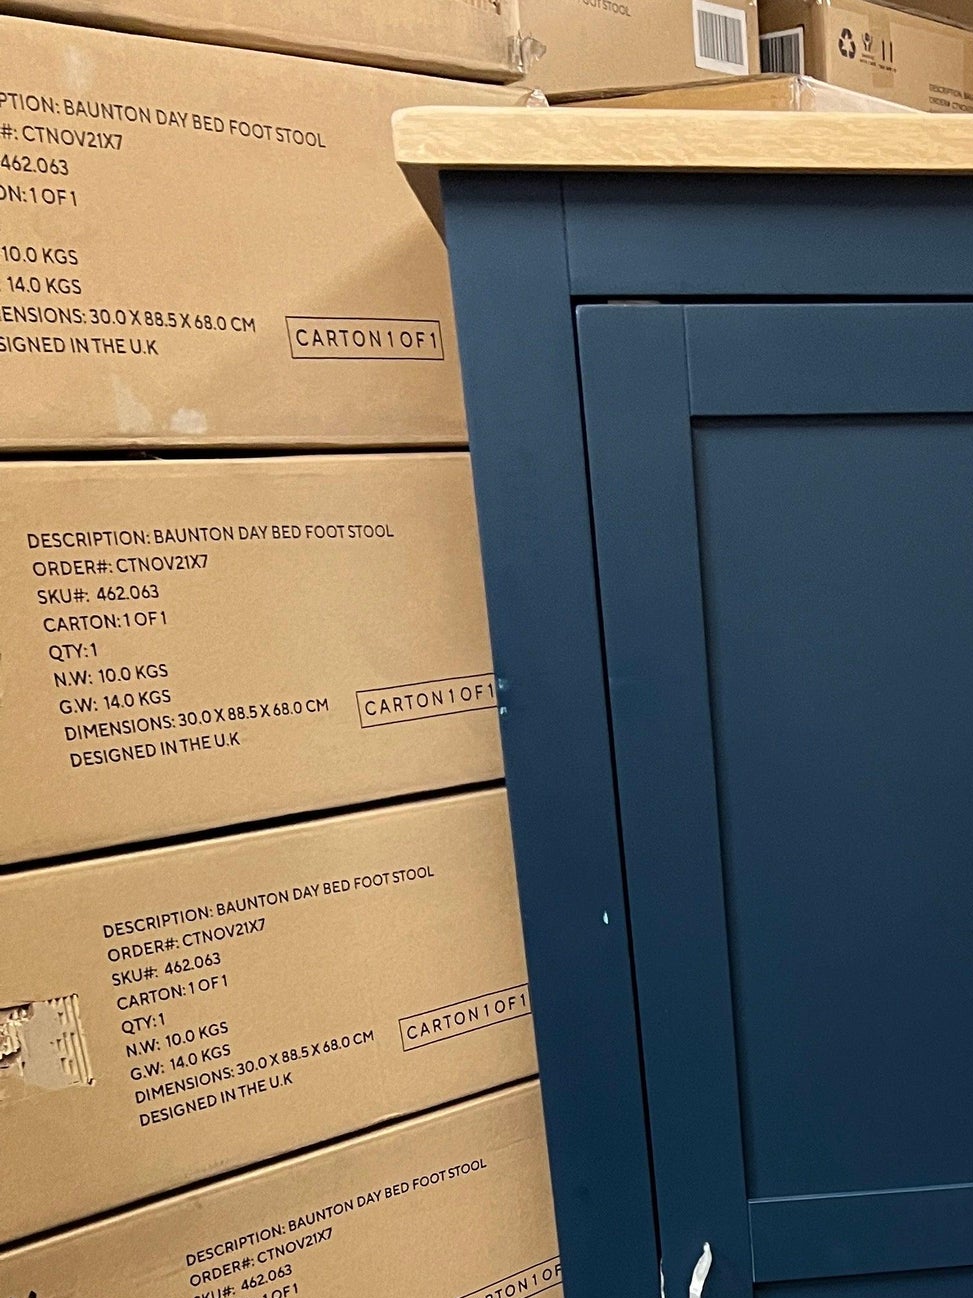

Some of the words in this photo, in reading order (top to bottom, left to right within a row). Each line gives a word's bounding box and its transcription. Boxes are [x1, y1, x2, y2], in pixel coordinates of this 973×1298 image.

[22, 125, 123, 151] CTNOV21X7
[63, 99, 151, 124] BAUNTON
[155, 109, 188, 128] DAY
[192, 114, 225, 133] BED
[229, 119, 273, 141] FOOT
[275, 126, 327, 149] STOOL
[0, 154, 69, 176] 462.063
[1, 245, 38, 263] 10.0
[42, 247, 79, 266] KGS
[6, 276, 41, 294] 14.0
[45, 277, 82, 295] KGS
[89, 308, 126, 325] 30.0
[144, 311, 177, 328] 88.5
[194, 314, 227, 331] 68.0
[231, 316, 256, 333] CM
[129, 338, 159, 355] U.K
[295, 328, 382, 348] CARTON
[400, 331, 425, 348] OF
[27, 530, 151, 549] DESCRIPTION:
[153, 526, 234, 544] BAUNTON
[238, 525, 268, 540] DAY
[271, 525, 302, 539] BED
[305, 525, 345, 539] FOOT
[347, 524, 394, 538] STOOL
[32, 559, 113, 577] ORDER#:
[116, 554, 208, 573] CTNOV21X7
[37, 588, 90, 605] SKU#:
[96, 584, 159, 602] 462.063
[53, 670, 93, 688] N.W:
[98, 666, 131, 683] 10.0
[135, 663, 168, 680] KGS
[59, 697, 98, 715] G.W:
[103, 693, 135, 710] 14.0
[138, 689, 171, 706] KGS
[364, 690, 444, 716] CARTON
[460, 684, 483, 701] OF
[64, 715, 176, 741] DIMENSIONS:
[177, 710, 212, 727] 30.0
[227, 705, 258, 721] 88.5
[273, 701, 303, 717] 68.0
[305, 698, 329, 713] CM
[70, 743, 157, 768] DESIGNED
[213, 731, 241, 748] U.K
[102, 906, 214, 939] DESCRIPTION:
[216, 890, 289, 916] BAUNTON
[292, 883, 320, 901] DAY
[323, 879, 351, 895] BED
[354, 872, 390, 890] FOOT
[392, 865, 435, 883] STOOL
[107, 937, 180, 962] ORDER#:
[182, 917, 265, 947] CTNOV21X7
[111, 966, 159, 987] SKU#:
[164, 952, 221, 975] 462.063
[406, 1006, 479, 1040] CARTON
[494, 996, 516, 1013] OF
[125, 1038, 161, 1058] N.W:
[165, 1029, 195, 1048] 10.0
[198, 1021, 229, 1040] KGS
[130, 1061, 165, 1081] G.W:
[169, 1052, 198, 1071] 14.0
[201, 1044, 231, 1063] KGS
[135, 1067, 235, 1104] DIMENSIONS:
[236, 1056, 267, 1076] 30.0
[281, 1046, 309, 1063] 88.5
[322, 1036, 350, 1053] 68.0
[353, 1029, 374, 1045] CM
[139, 1094, 217, 1127] DESIGNED
[269, 1072, 293, 1089] U.K
[288, 1199, 354, 1232] BAUNTON
[356, 1189, 382, 1208] DAY
[384, 1182, 410, 1199] BED
[412, 1169, 446, 1191] FOOT
[448, 1158, 487, 1179] STOOL
[257, 1226, 333, 1264] CTNOV21X7
